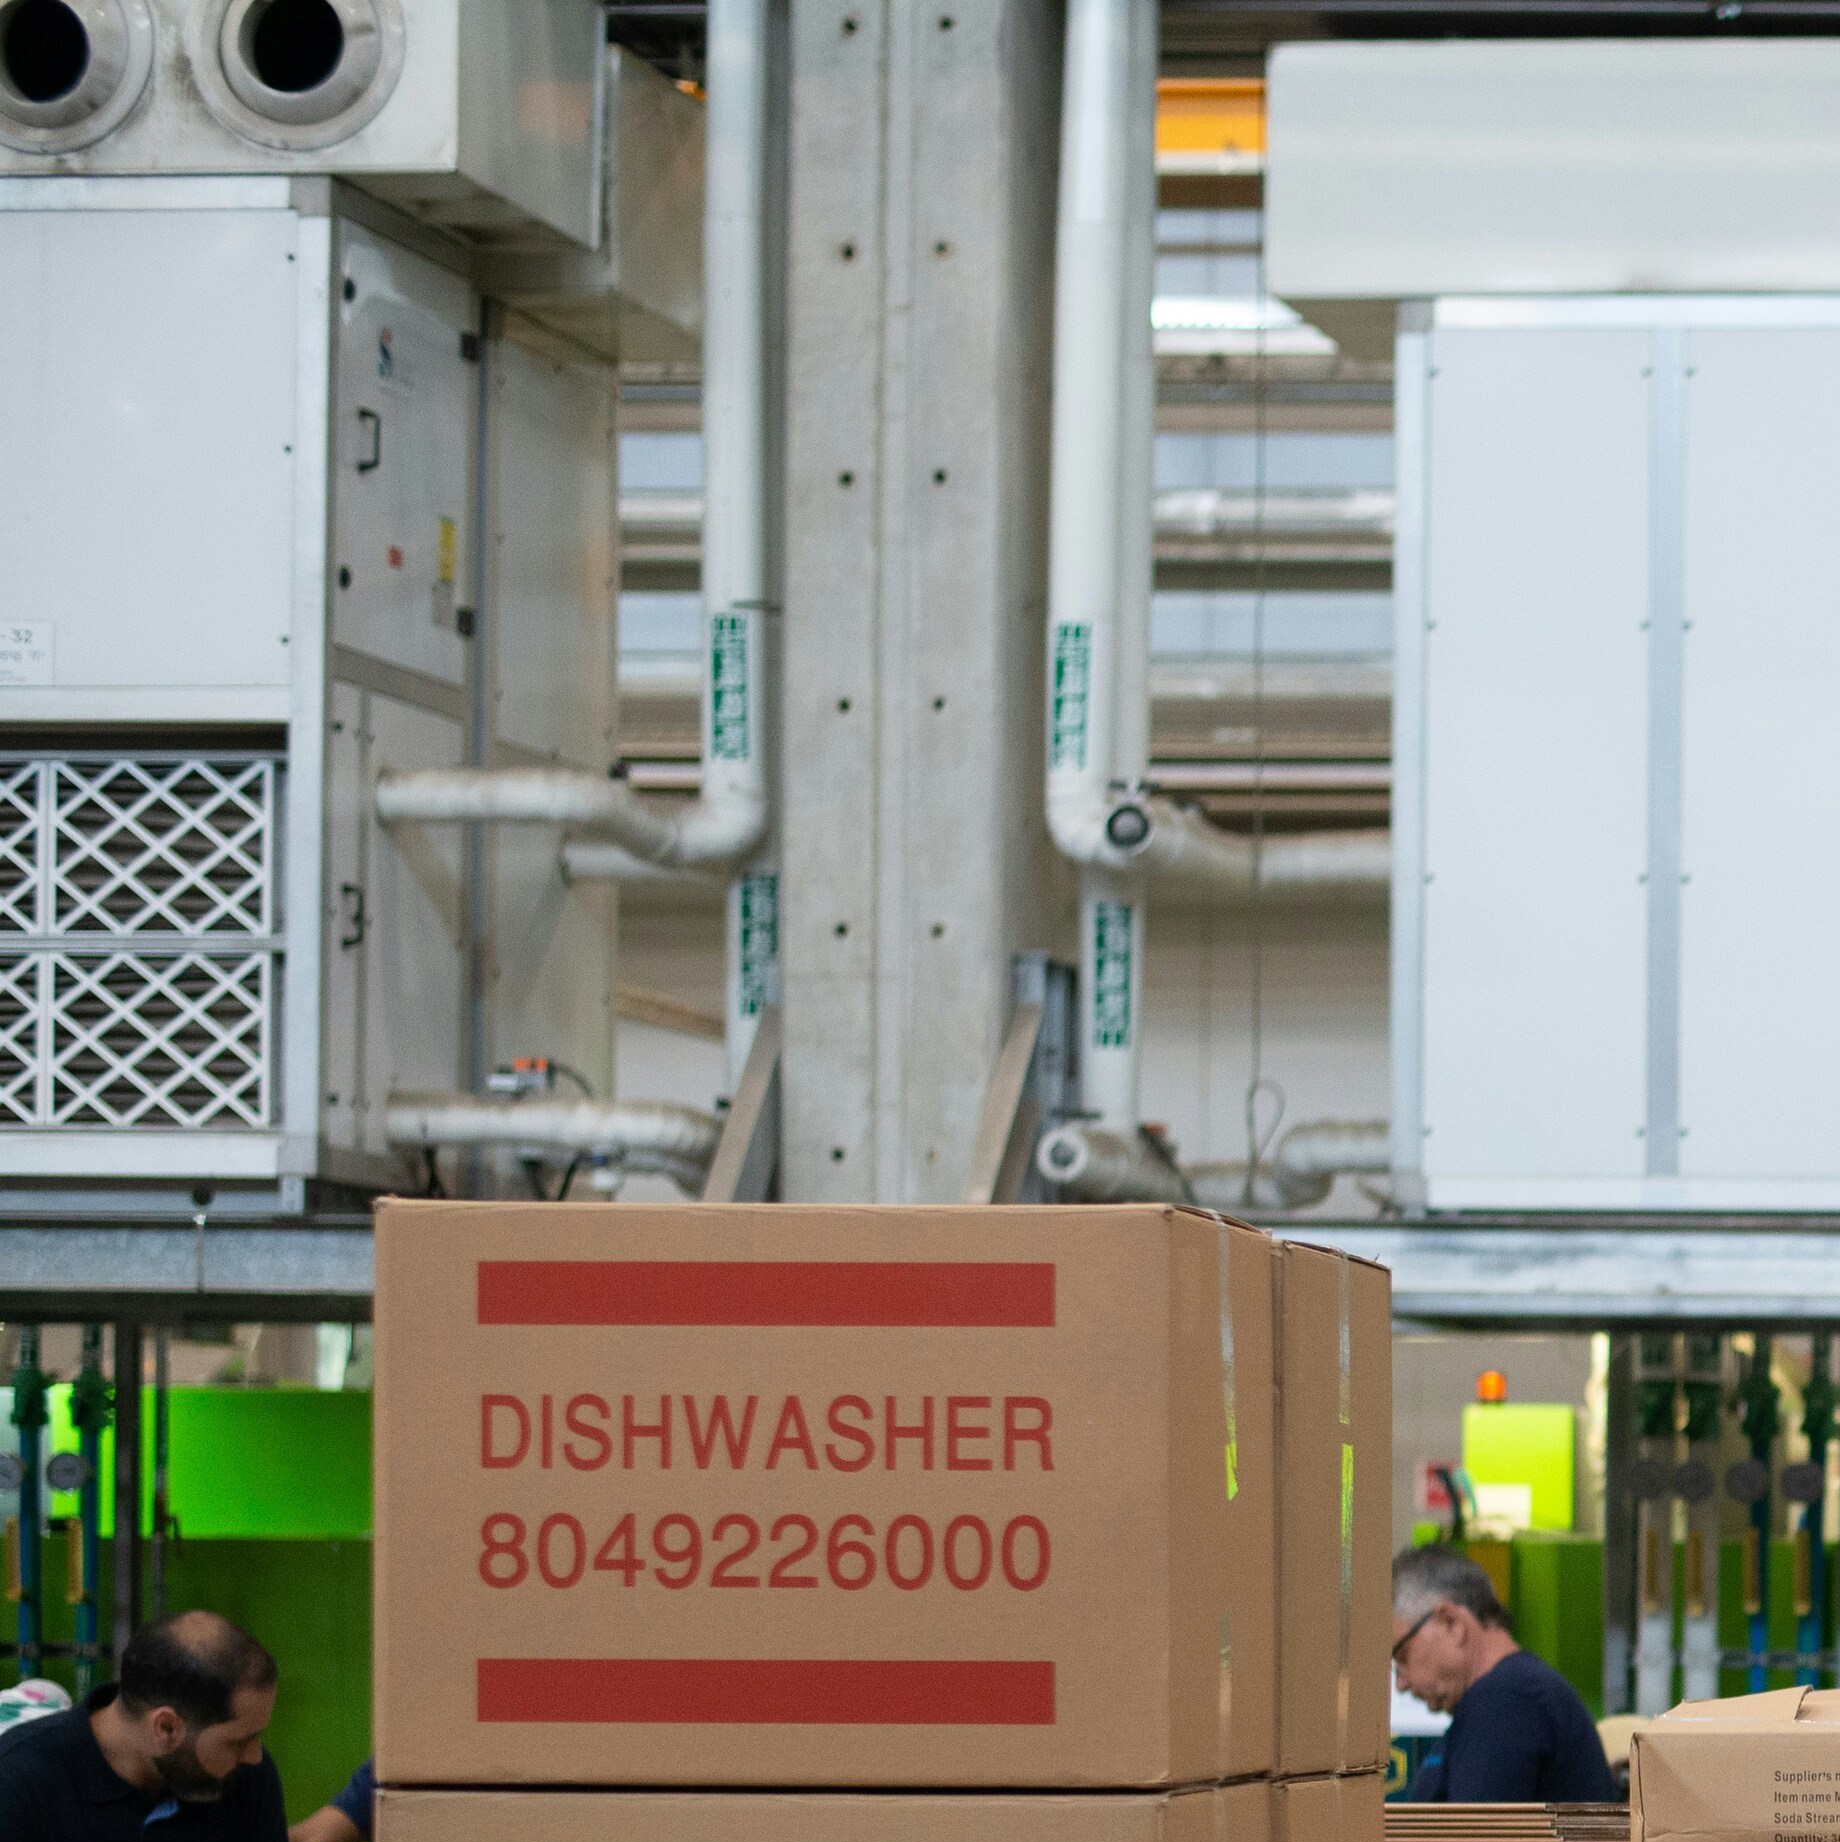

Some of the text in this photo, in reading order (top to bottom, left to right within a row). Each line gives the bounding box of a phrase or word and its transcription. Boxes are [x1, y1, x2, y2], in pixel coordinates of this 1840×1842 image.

[480, 1393, 1055, 1472] DISHWASHER
[478, 1512, 1051, 1591] 8049226000
[1773, 1770, 1833, 1785] Supplier's
[1773, 1791, 1799, 1803] Item
[1801, 1793, 1832, 1803] name
[1774, 1812, 1804, 1824] Soda
